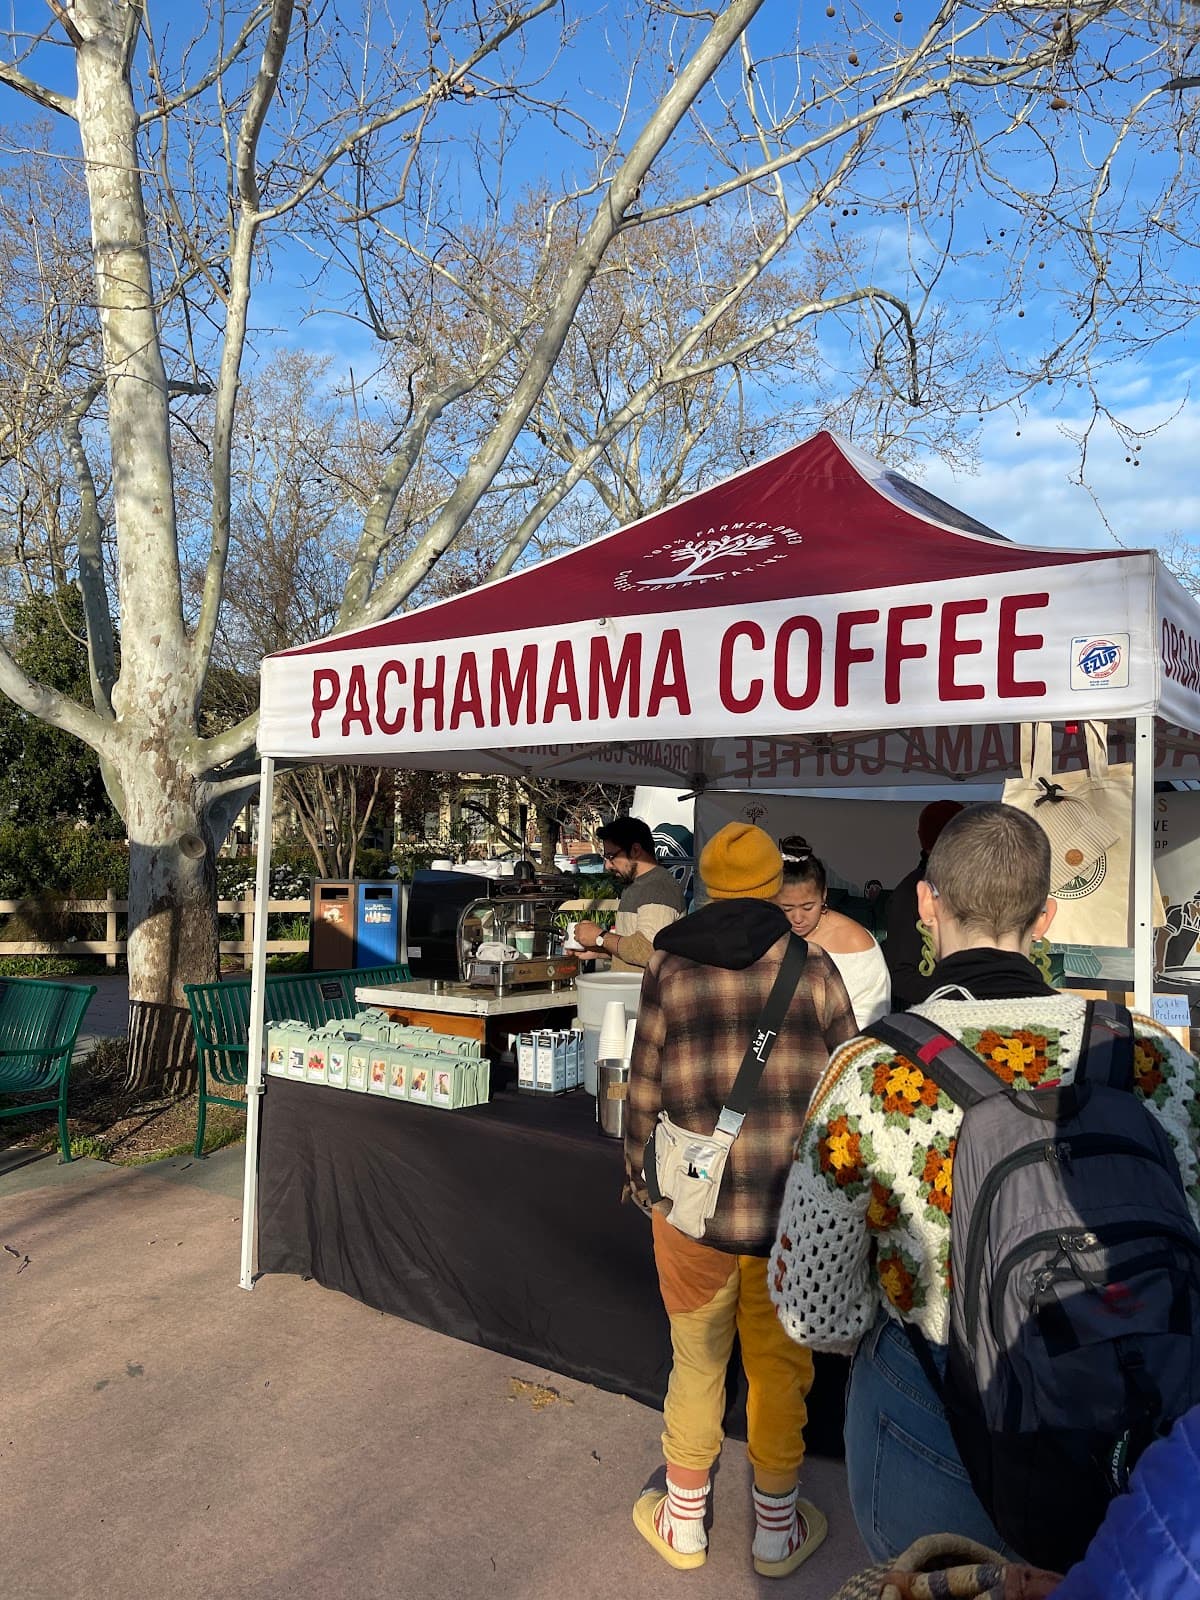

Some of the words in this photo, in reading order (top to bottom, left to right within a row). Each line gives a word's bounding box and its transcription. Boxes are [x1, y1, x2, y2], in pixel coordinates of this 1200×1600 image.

[696, 521, 803, 545] FARMER-OWNED
[637, 554, 788, 592] COOPERATIVE
[311, 629, 692, 739] PACHAMAMA
[719, 592, 1050, 714] COFFEE
